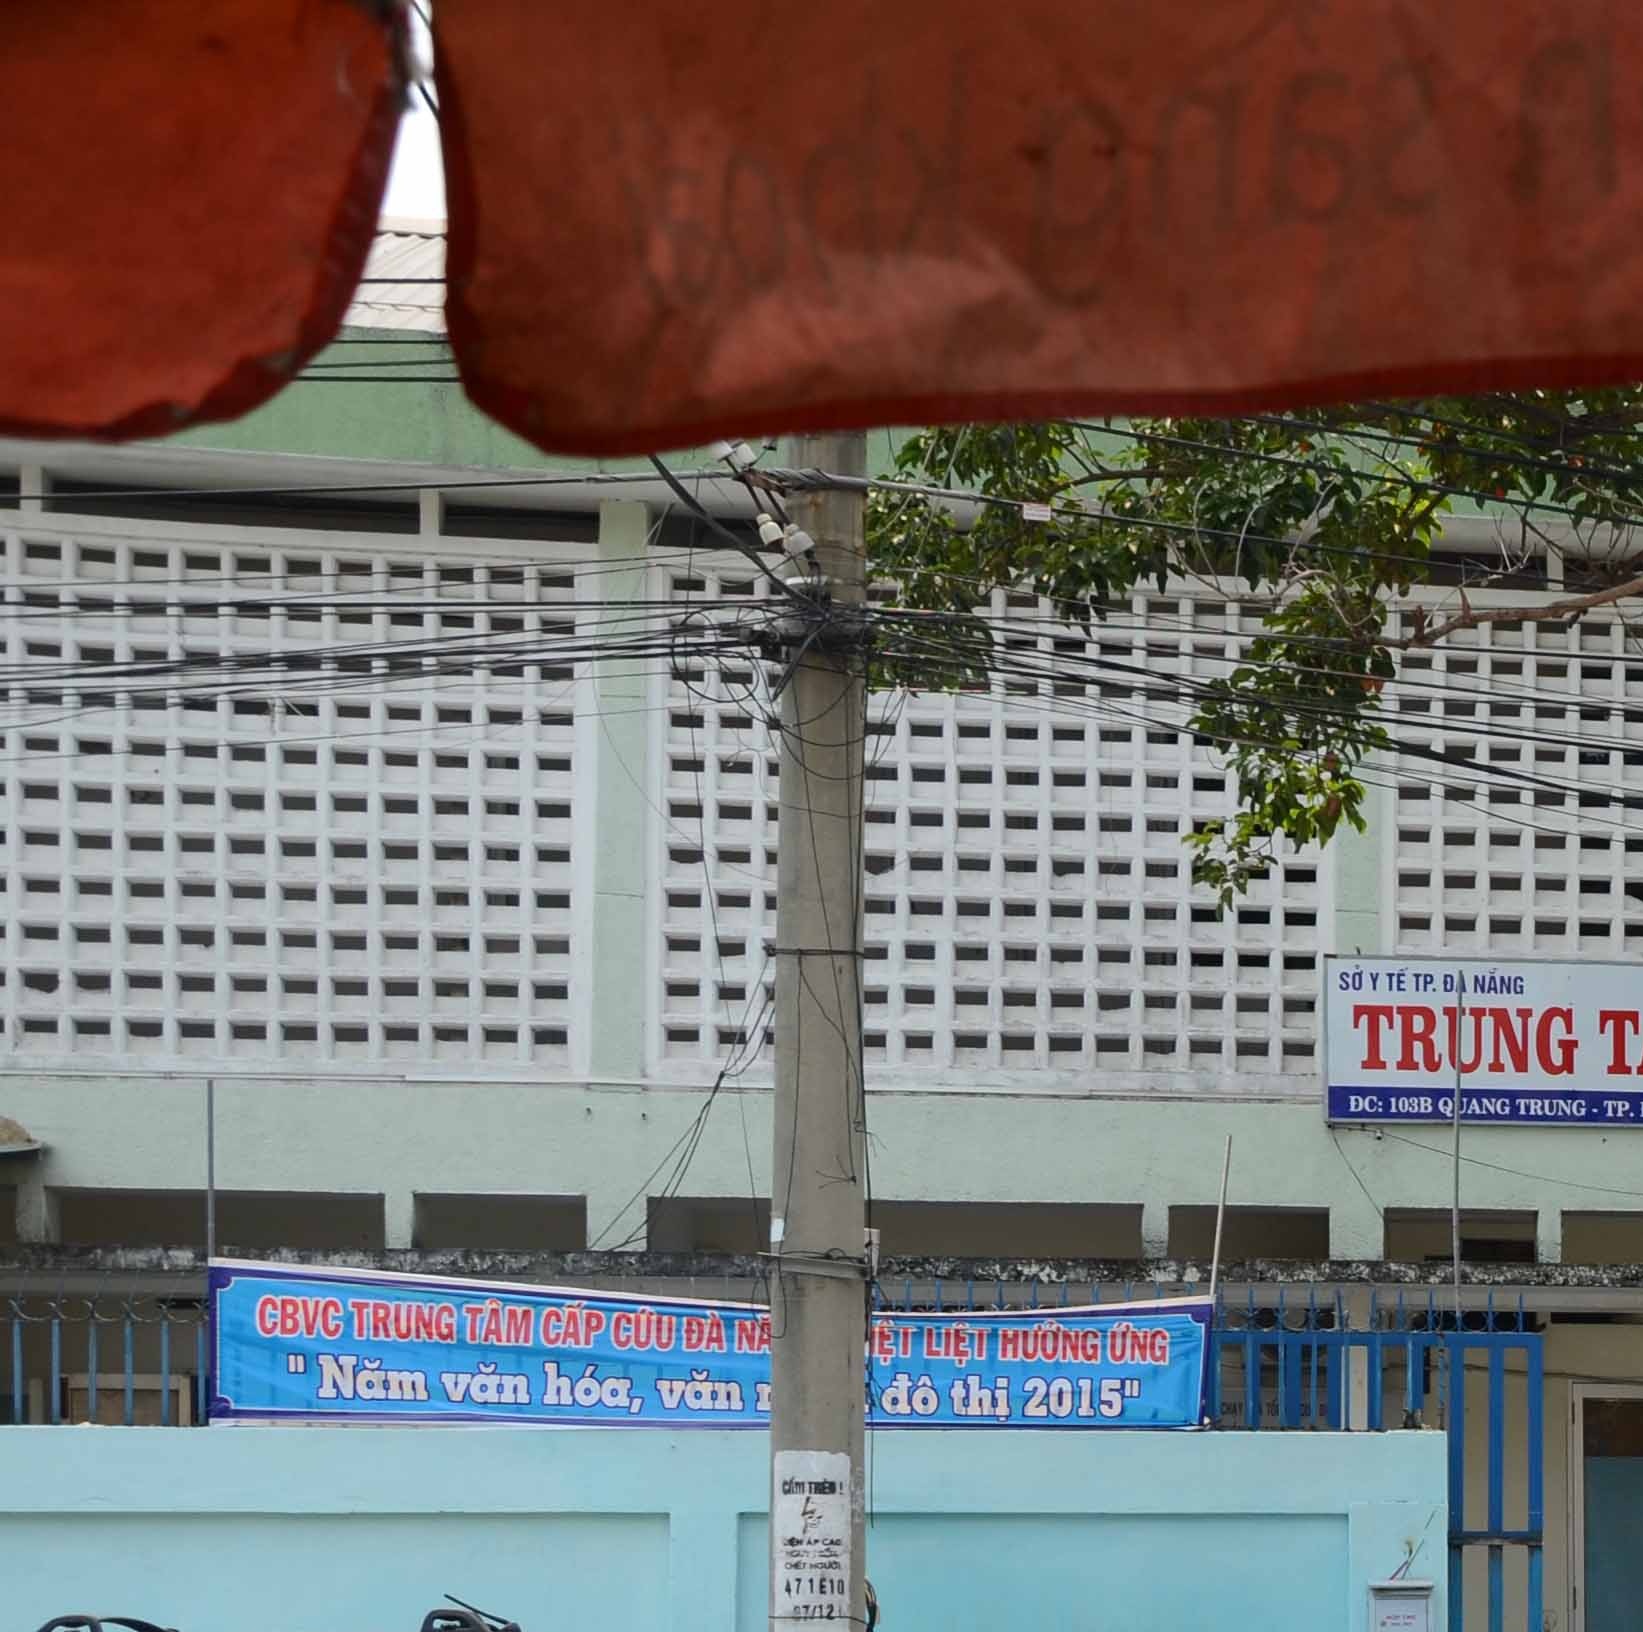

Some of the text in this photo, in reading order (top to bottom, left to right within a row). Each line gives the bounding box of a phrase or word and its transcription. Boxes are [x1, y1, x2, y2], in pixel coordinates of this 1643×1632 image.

[1338, 965, 1364, 992] SỞ
[1369, 972, 1380, 991] Y
[1386, 967, 1408, 992] TẾ
[1413, 973, 1437, 993] TP.
[1352, 1003, 1579, 1077] TRUNG
[1349, 1095, 1383, 1113] ĐC:
[1389, 1096, 1433, 1114] 103B
[1437, 1097, 1511, 1117] QUANG
[1516, 1098, 1586, 1117] TRUNG
[1603, 1101, 1634, 1118] TP.
[257, 1296, 343, 1340] CBVC
[350, 1300, 456, 1343] TRUNG
[464, 1298, 533, 1347] TÂM
[541, 1302, 604, 1348] CẤP
[684, 1310, 727, 1352] ĐÀ
[923, 1319, 992, 1367] LIỆT
[317, 1353, 430, 1401] Năm
[440, 1361, 531, 1406] văn
[543, 1361, 644, 1414] hóa,
[655, 1368, 745, 1412] văn
[881, 1372, 939, 1417] đô
[950, 1373, 1011, 1422] thị
